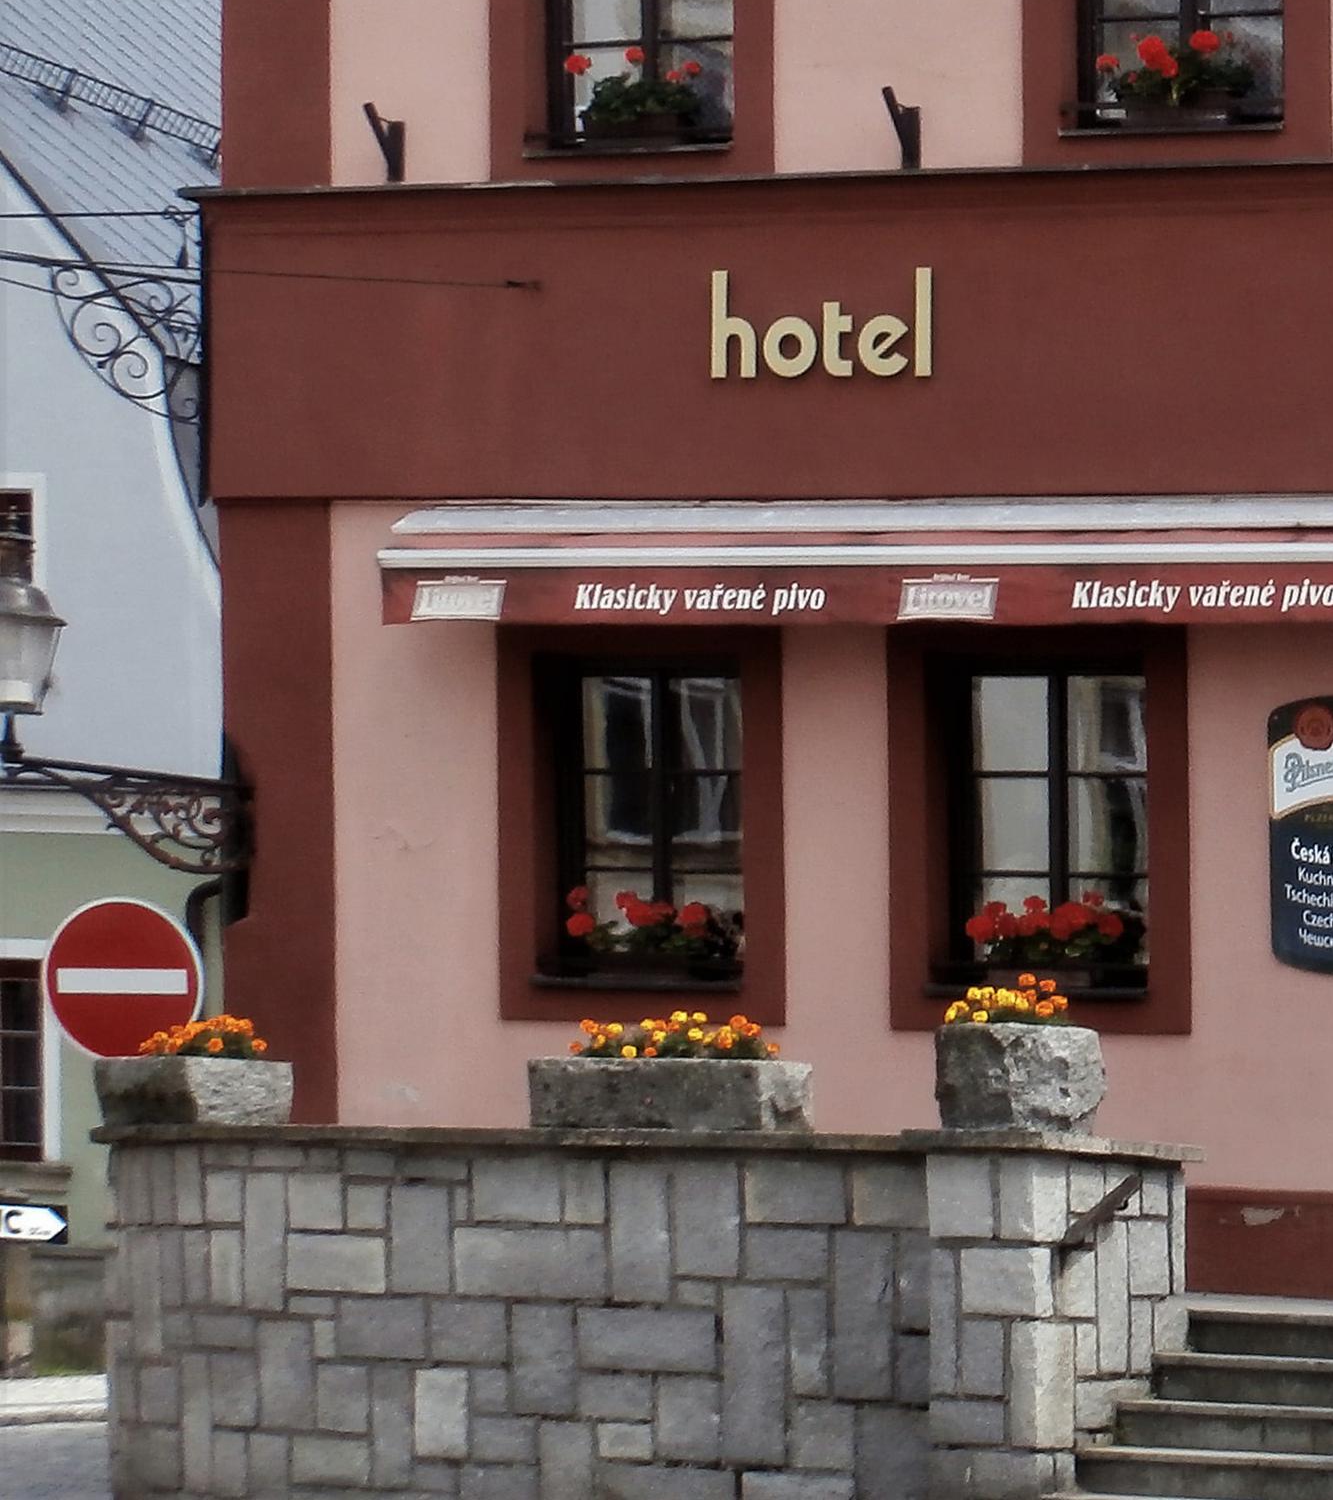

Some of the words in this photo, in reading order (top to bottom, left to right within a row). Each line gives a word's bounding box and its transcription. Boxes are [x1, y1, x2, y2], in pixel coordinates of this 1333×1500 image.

[711, 266, 933, 379] hotel
[574, 583, 677, 615] Klasicky
[684, 583, 767, 611] vařené
[771, 583, 826, 616] pivo
[1071, 580, 1181, 613] Klasicky
[1187, 579, 1275, 607] vařené
[1291, 837, 1331, 864] Česká
